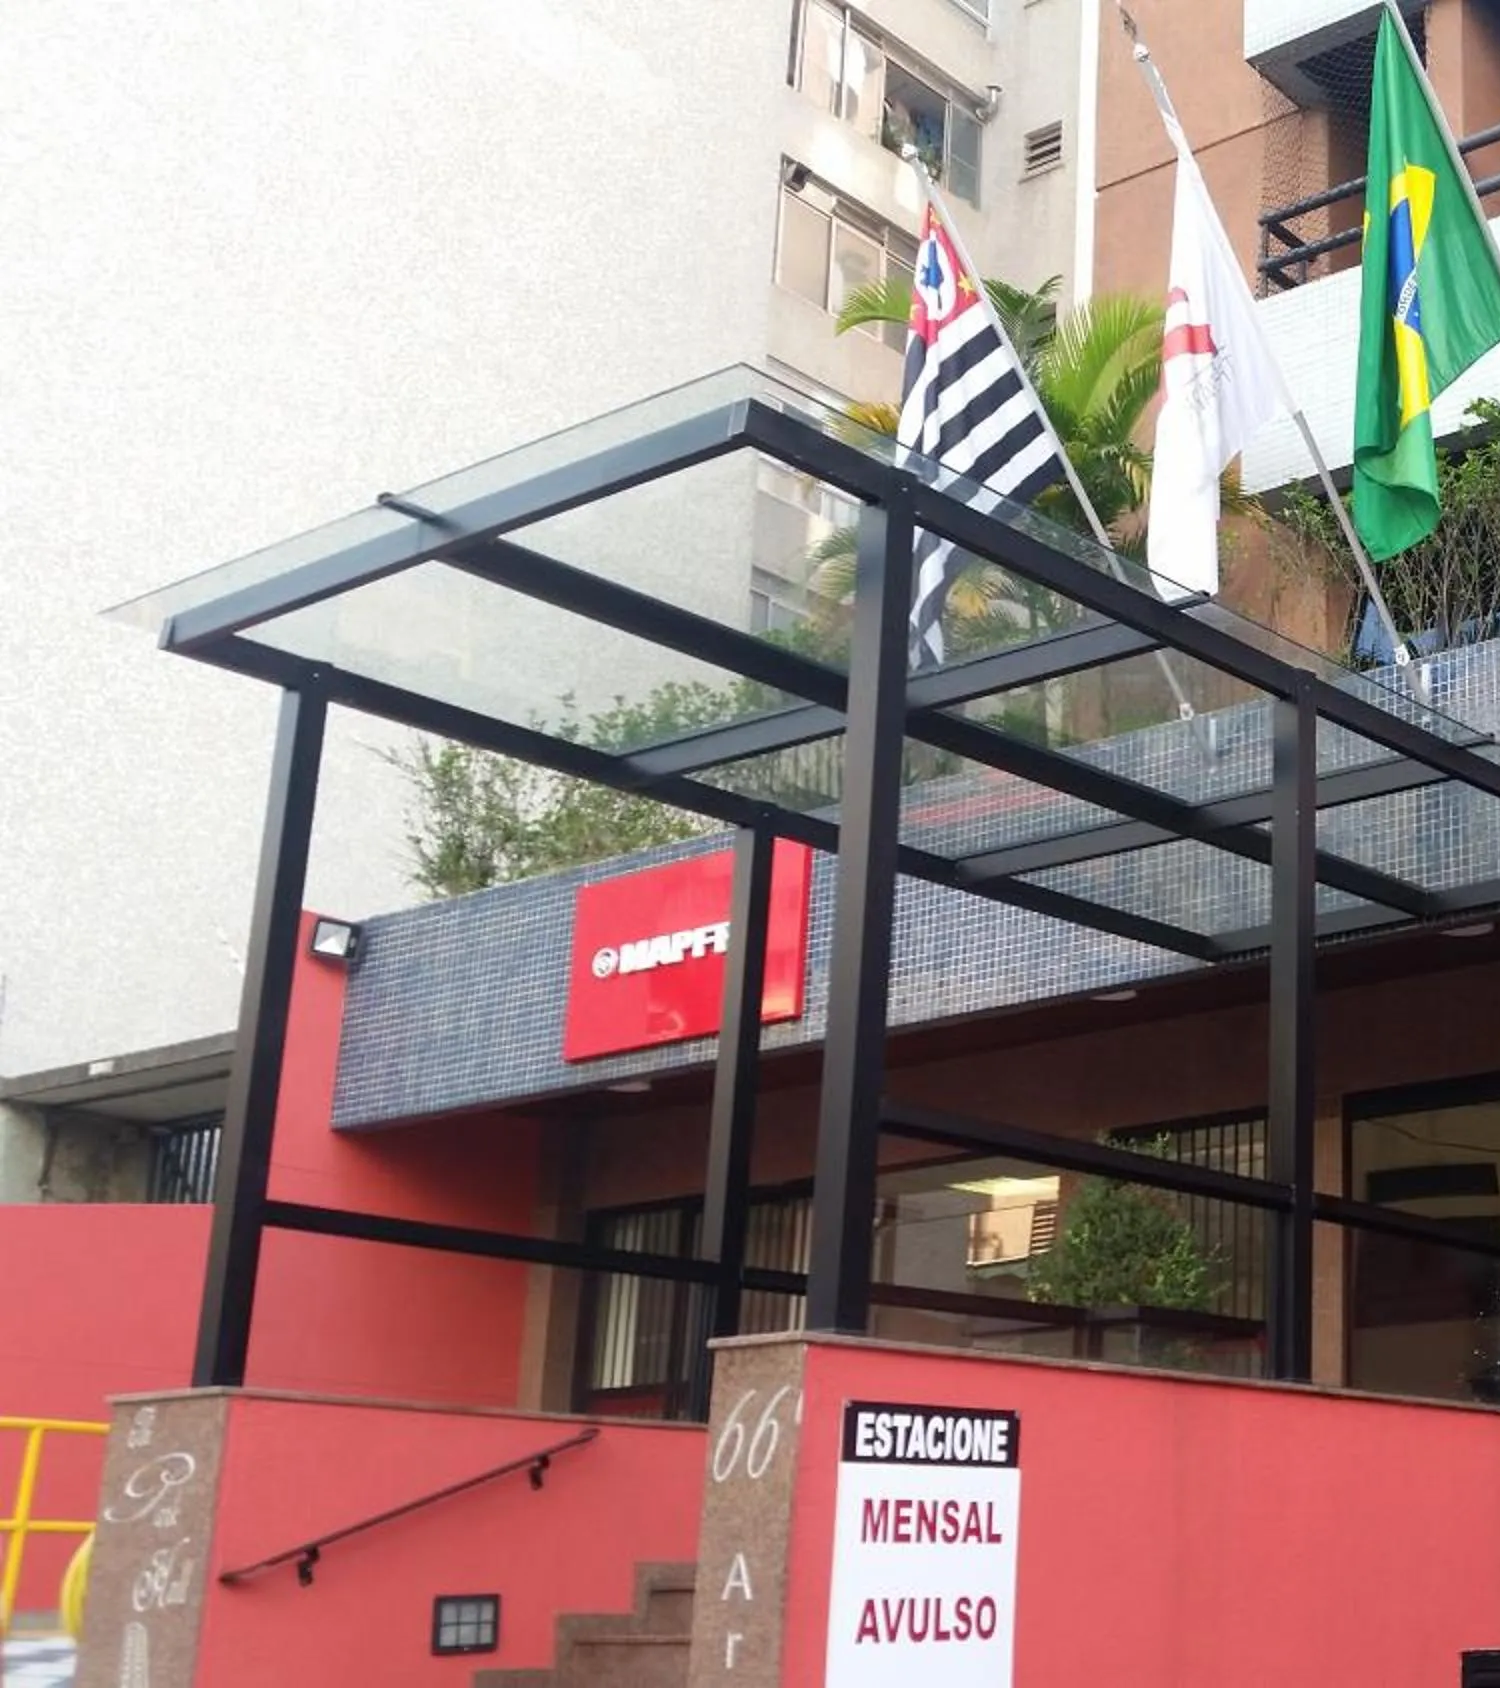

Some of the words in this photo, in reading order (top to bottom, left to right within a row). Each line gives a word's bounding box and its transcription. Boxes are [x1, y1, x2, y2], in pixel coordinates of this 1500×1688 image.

[618, 921, 731, 975] MAPFR
[855, 1412, 1009, 1463] ESTACIONE
[861, 1498, 1003, 1545] MENSAL
[855, 1596, 997, 1645] AVULSO
